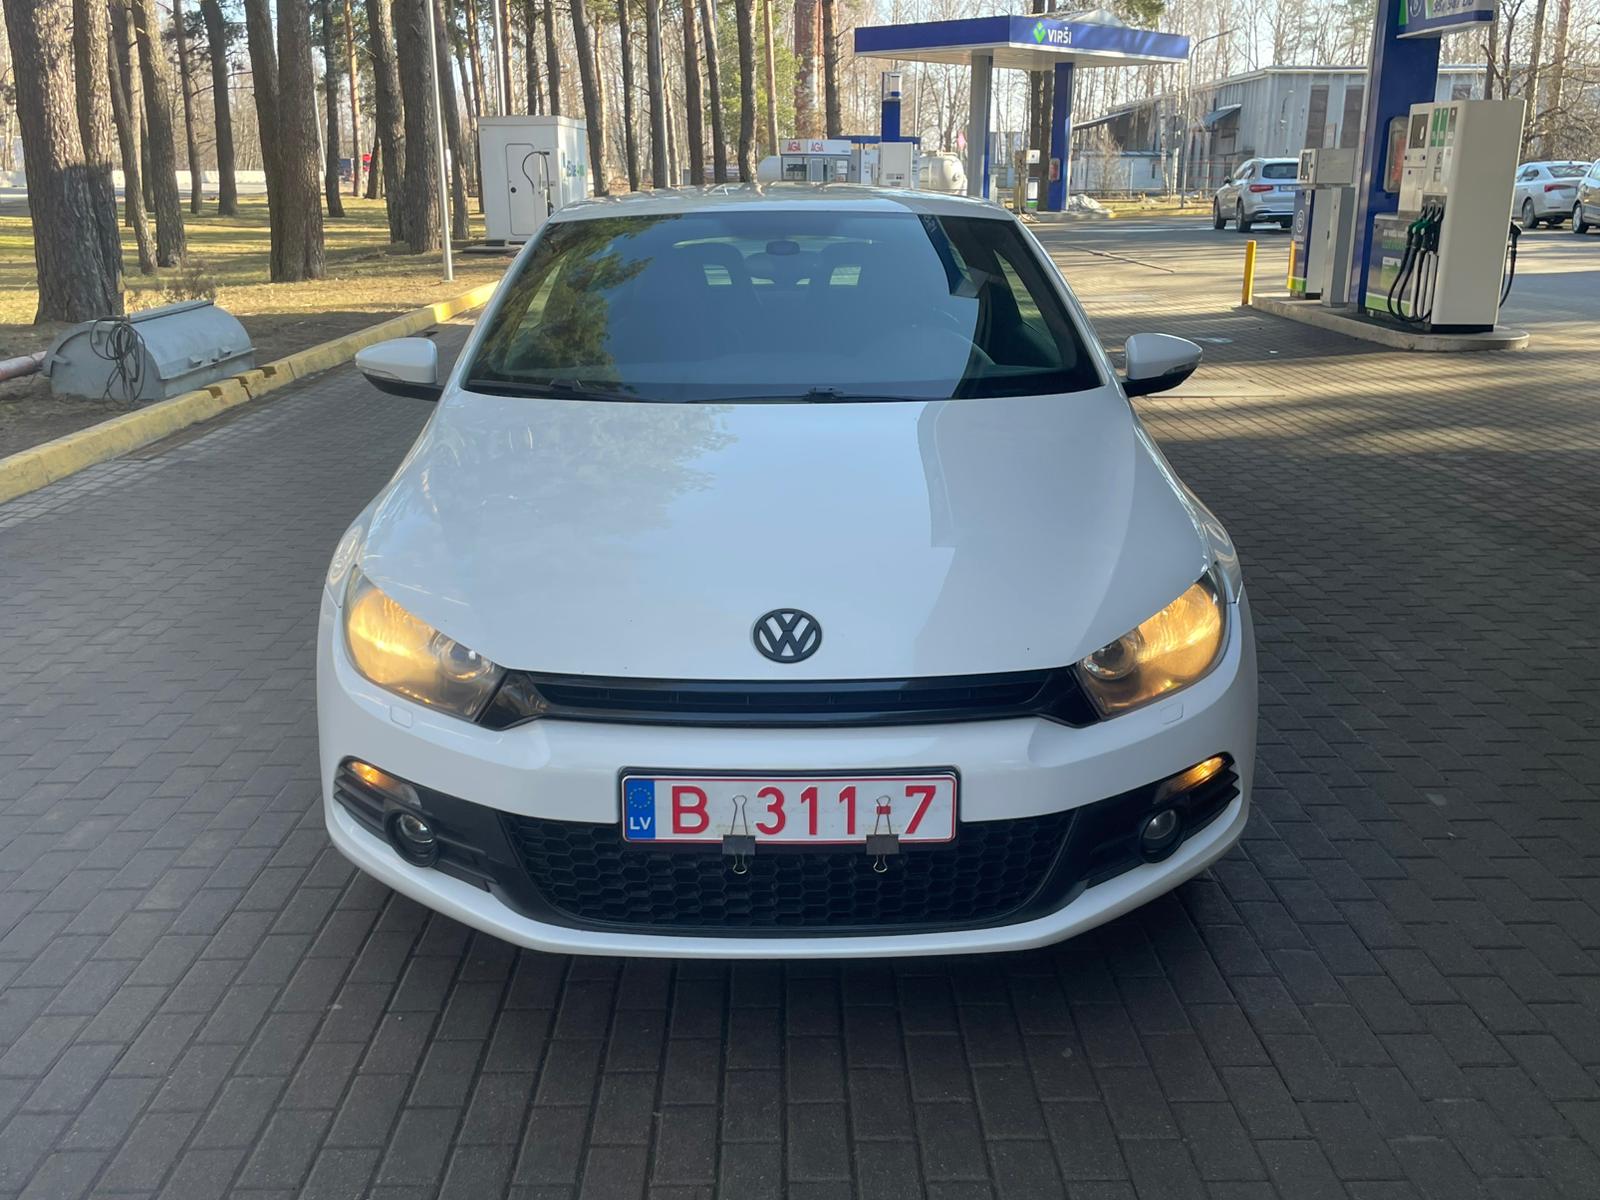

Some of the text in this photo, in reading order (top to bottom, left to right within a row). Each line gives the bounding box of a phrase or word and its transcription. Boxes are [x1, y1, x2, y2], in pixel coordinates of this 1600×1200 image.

[1047, 27, 1072, 44] VIRŠI
[787, 140, 801, 152] AGA
[811, 142, 824, 152] AGA
[672, 786, 710, 834] B
[630, 817, 651, 830] LV
